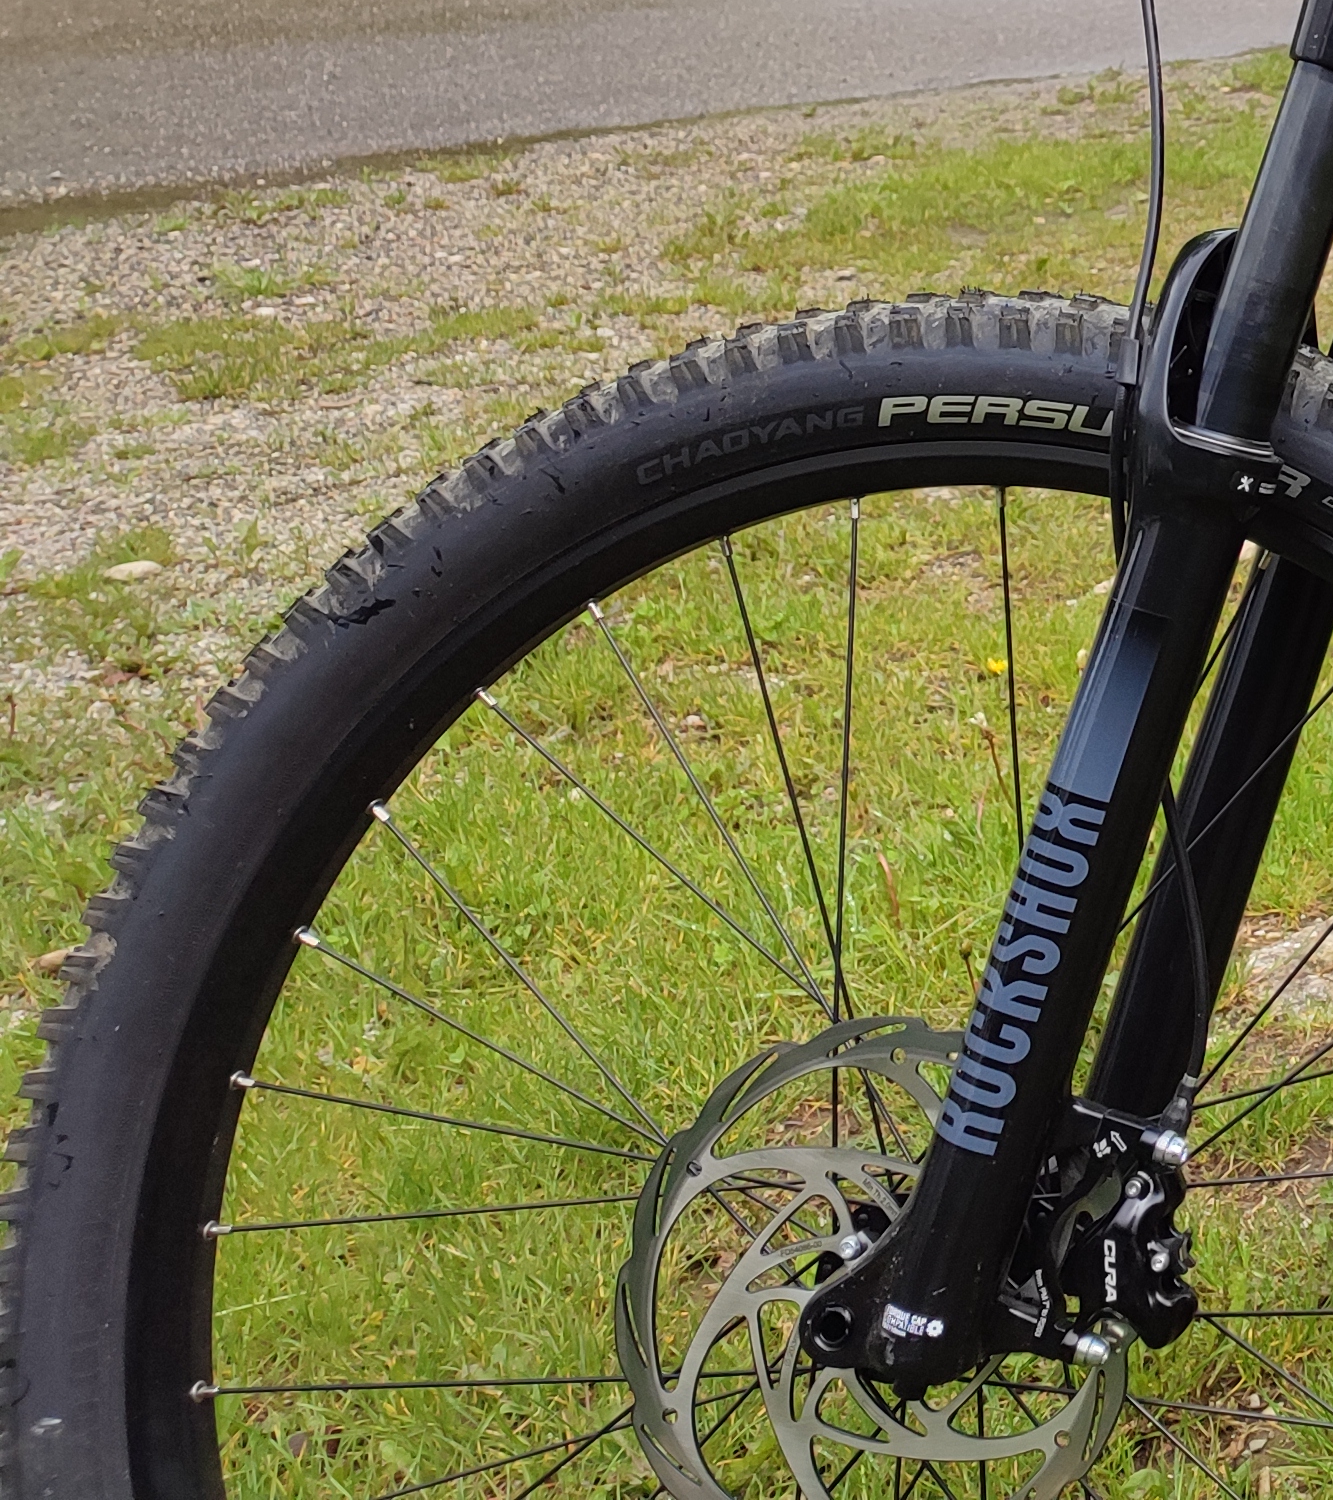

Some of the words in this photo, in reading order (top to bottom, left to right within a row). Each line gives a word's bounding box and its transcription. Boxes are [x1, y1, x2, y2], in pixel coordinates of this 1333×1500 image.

[636, 405, 865, 486] CHAOYANG
[935, 785, 1108, 1157] ROCKSHOX
[1103, 1238, 1118, 1303] CURA
